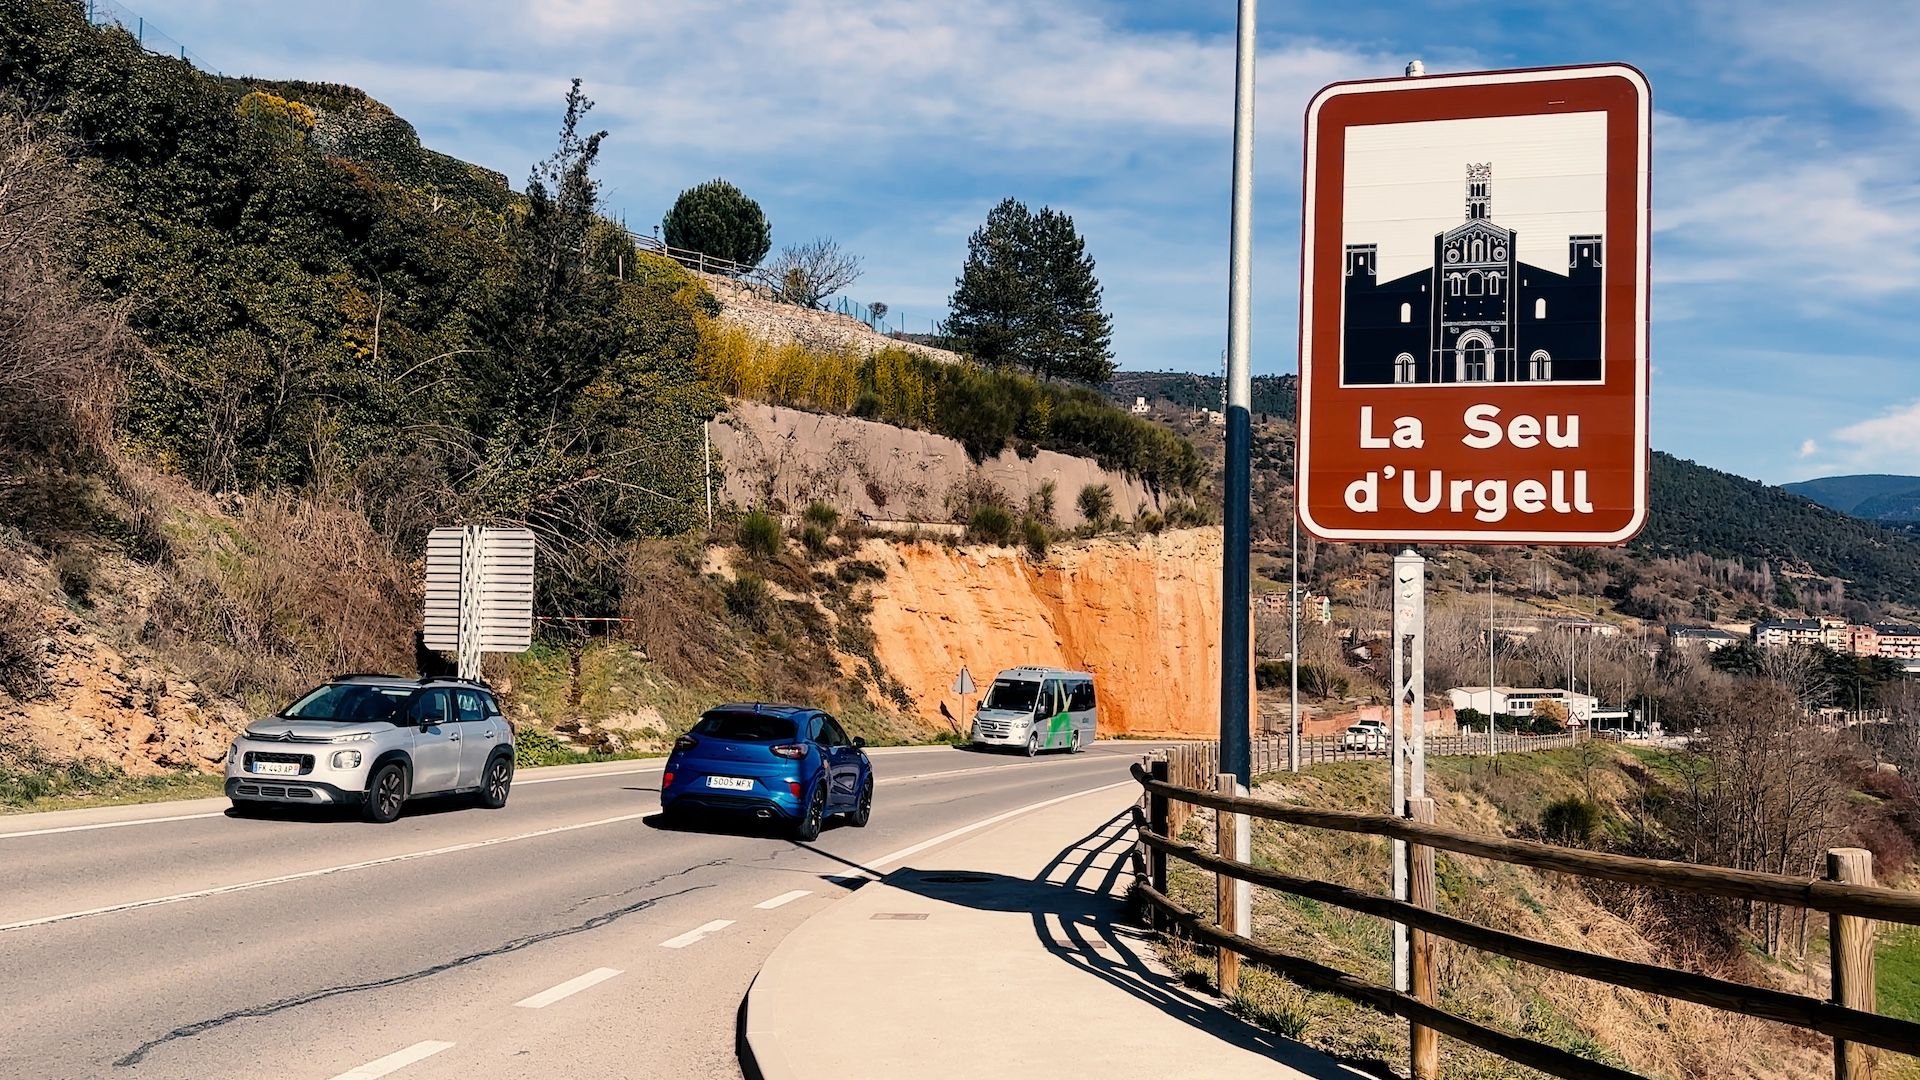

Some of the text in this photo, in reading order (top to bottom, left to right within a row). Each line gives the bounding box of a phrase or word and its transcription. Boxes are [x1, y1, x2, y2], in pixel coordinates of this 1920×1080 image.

[1360, 403, 1580, 449] La Seu
[1344, 465, 1594, 523] d'Urgell
